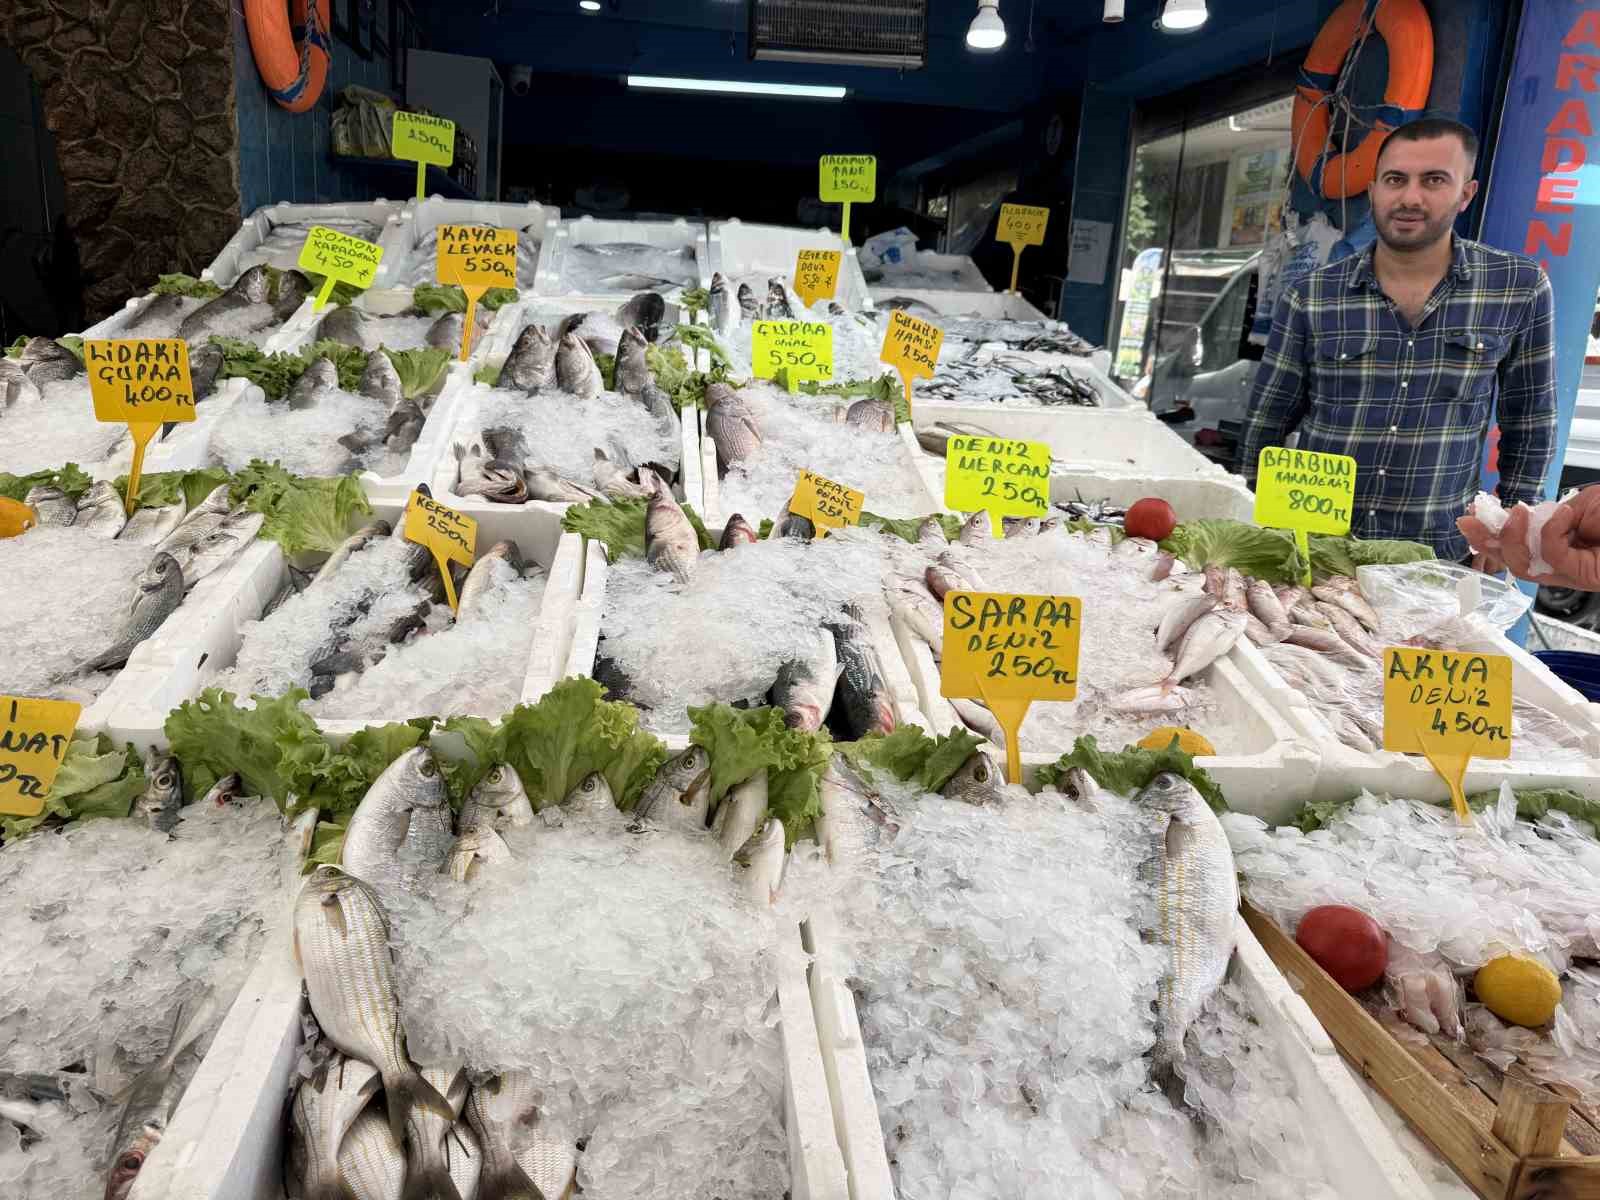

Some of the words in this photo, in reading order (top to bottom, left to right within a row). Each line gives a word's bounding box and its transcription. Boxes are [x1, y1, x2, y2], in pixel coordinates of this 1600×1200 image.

[312, 228, 377, 254] SOMON
[442, 226, 497, 243] KAYA
[447, 243, 516, 257] LEVREK
[98, 362, 181, 385] ÇUPRA
[1264, 448, 1351, 476] BARBUN
[804, 472, 855, 502] KEFAL
[416, 495, 470, 529] KEFAL
[1389, 651, 1488, 685] AKYA
